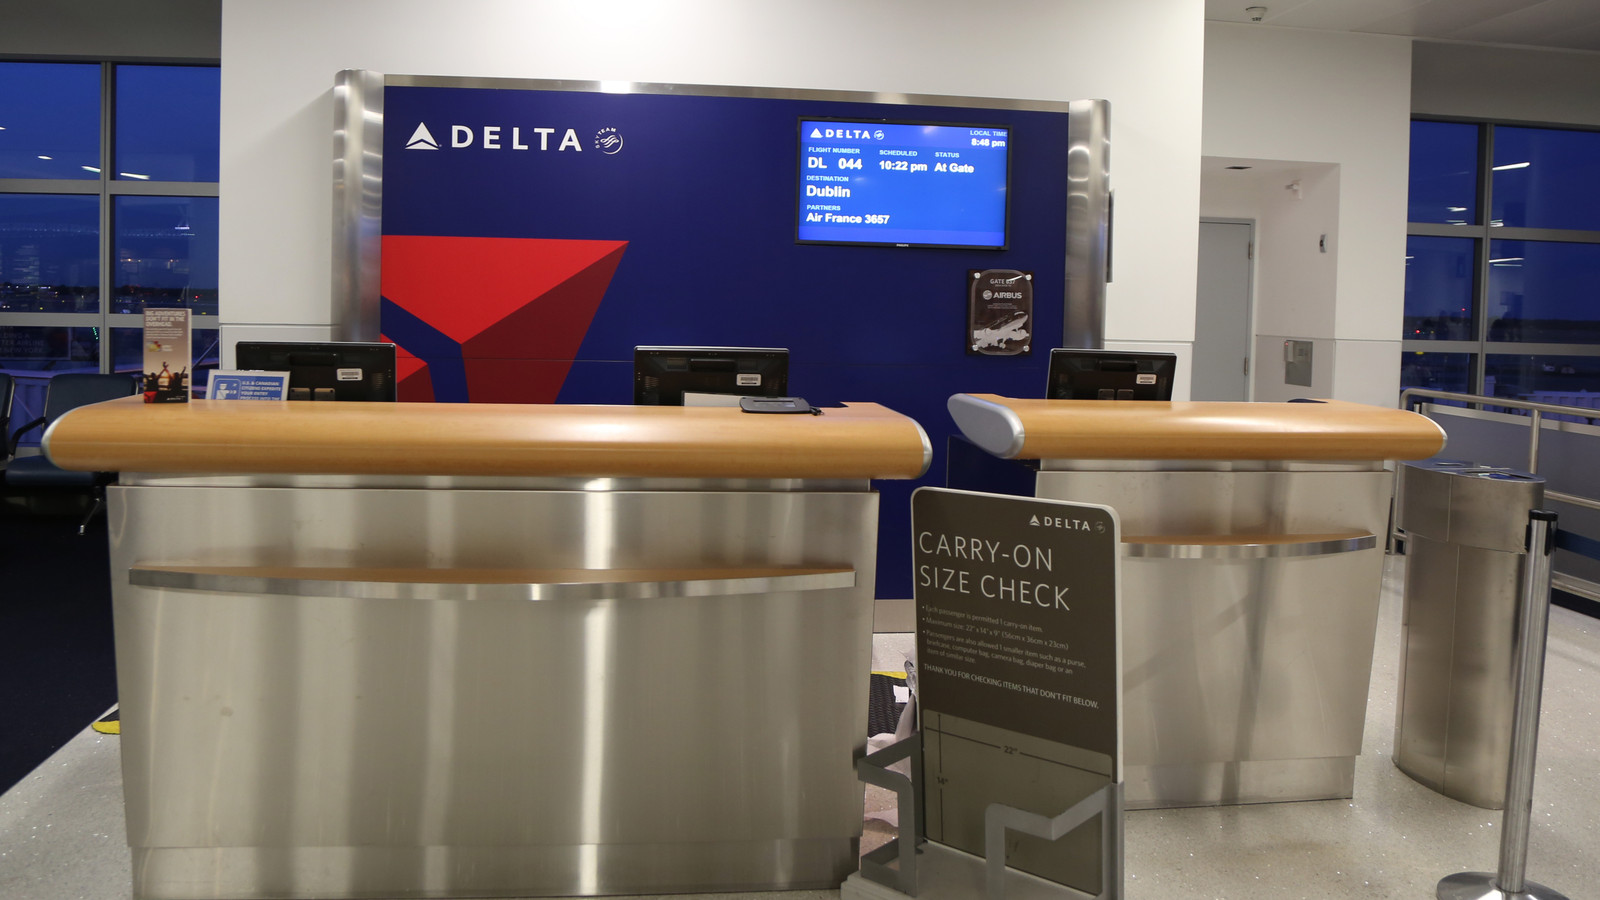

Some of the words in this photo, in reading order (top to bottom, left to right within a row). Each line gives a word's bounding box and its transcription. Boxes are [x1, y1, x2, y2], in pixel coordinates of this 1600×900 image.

[452, 125, 582, 151] DELTA
[594, 127, 616, 149] SKYTEAM
[825, 129, 870, 139] DELTA
[971, 138, 990, 146] 8:48
[991, 139, 1006, 148] pm
[879, 149, 917, 157] SCHEDULED
[808, 157, 827, 169] DL
[838, 158, 862, 170] 044
[879, 160, 908, 171] 10:22
[910, 162, 928, 173] pm
[934, 162, 948, 172] At
[949, 163, 975, 173] Gate
[806, 185, 851, 198] Dublin
[806, 213, 823, 223] Air
[825, 213, 862, 224] France
[864, 215, 890, 225] 3657
[993, 291, 1022, 299] AIRBUS
[1044, 516, 1091, 532] DELTA
[919, 531, 1053, 572] CARRY-ON
[920, 565, 970, 594] SIZE
[980, 575, 1070, 611] CHECK
[938, 608, 965, 618] passenger
[972, 614, 999, 624] permitted
[1003, 621, 1027, 629] carry-on
[1028, 624, 1043, 632] item.
[926, 617, 953, 628] Maximum
[1001, 631, 1021, 641] (56cm
[1026, 636, 1043, 645] 36cm
[1048, 640, 1069, 650] 23cm)
[926, 629, 955, 640] Passengers
[966, 637, 977, 646] also
[977, 641, 999, 650] allowed
[1003, 645, 1024, 655] smaller
[1024, 650, 1038, 658] item
[1039, 653, 1053, 661] such
[1067, 658, 1086, 668] purse,
[945, 652, 963, 661] similar
[952, 645, 978, 655] computer
[991, 653, 1012, 662] camera
[1025, 659, 1044, 668] diaper
[1045, 663, 1056, 673] bag
[924, 663, 943, 674] THANK
[943, 668, 957, 677] YOU
[957, 671, 971, 679] FOR
[970, 673, 1002, 687] CHECKING
[1002, 681, 1022, 692] ITEMS
[1022, 685, 1039, 696] THAT
[1039, 689, 1062, 700] DON'T
[1062, 694, 1073, 703] FIT
[1073, 697, 1099, 709] BELOW.
